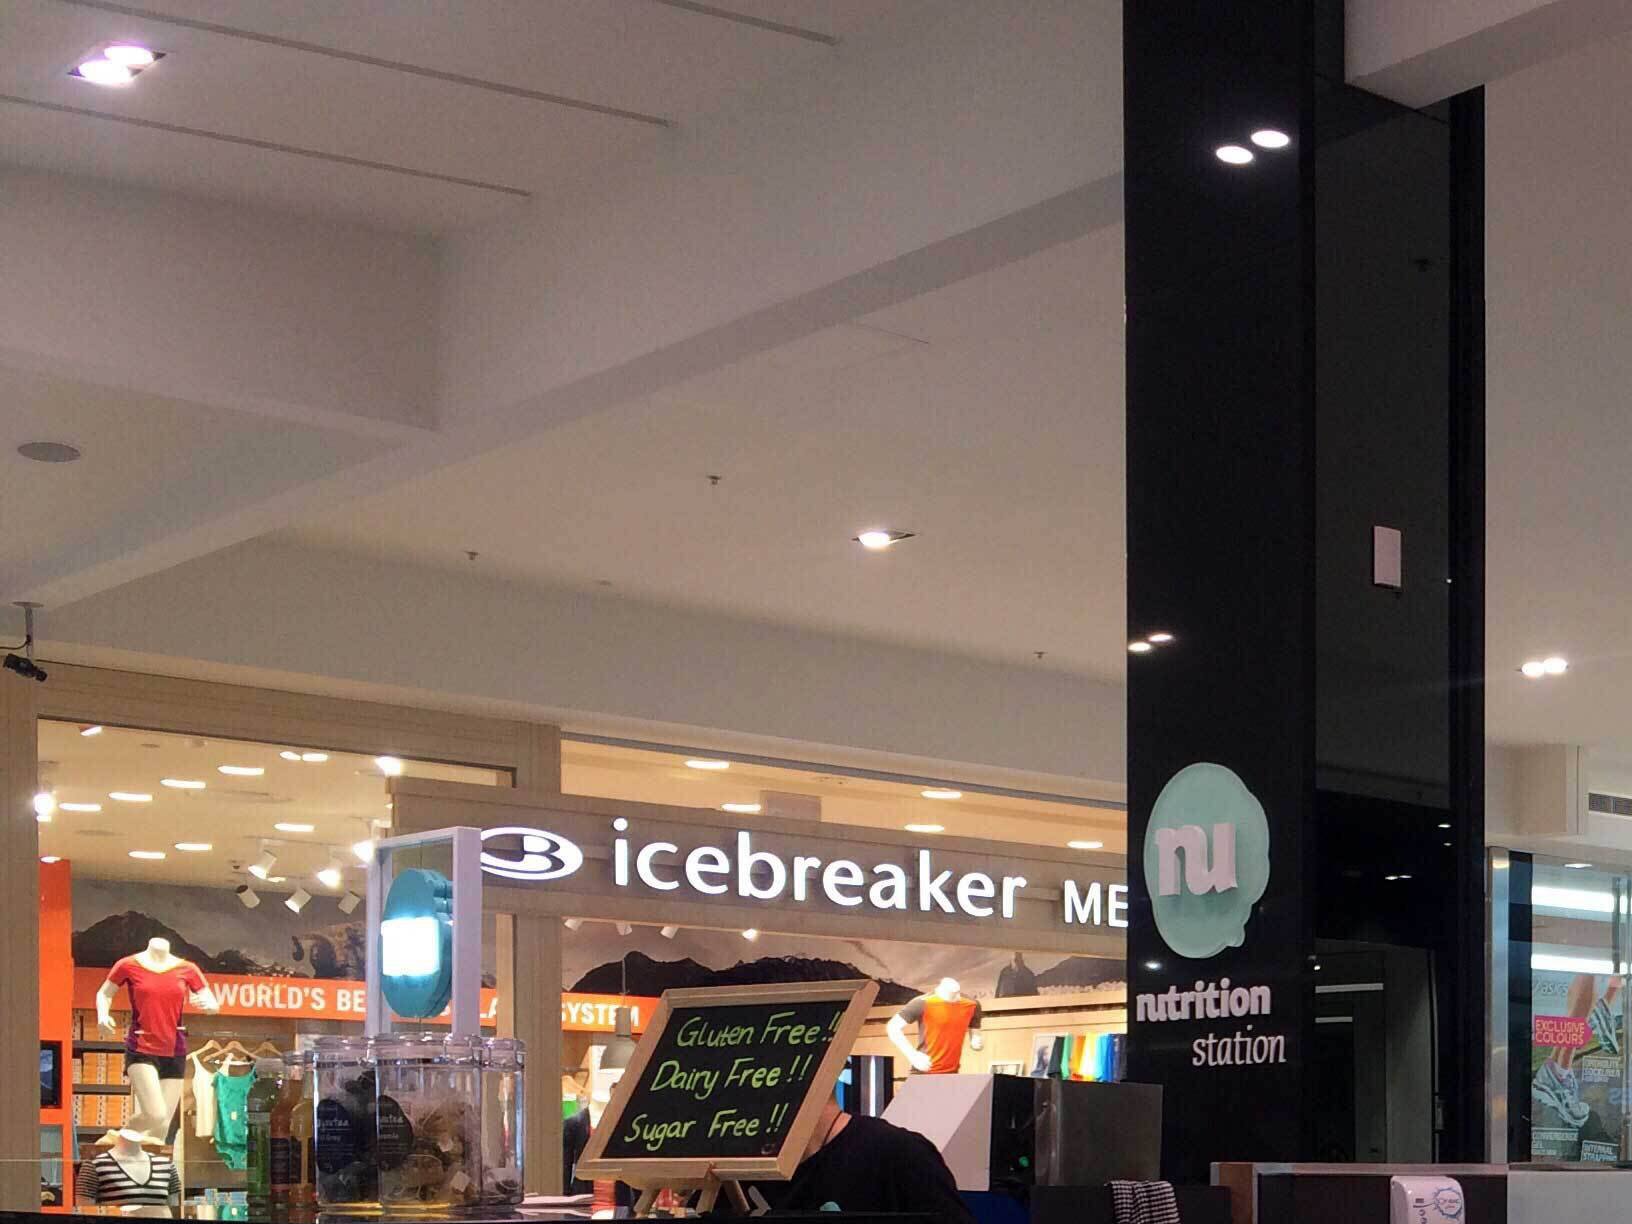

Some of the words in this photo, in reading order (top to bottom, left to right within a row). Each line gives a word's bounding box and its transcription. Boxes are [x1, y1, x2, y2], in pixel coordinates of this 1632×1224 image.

[612, 817, 1026, 920] icebreaker
[1153, 823, 1239, 897] nu
[217, 983, 326, 1011] WORLD'S
[562, 1003, 640, 1027] SYSTE
[1136, 978, 1272, 1022] nutrition
[676, 1016, 755, 1048] Gluten
[1192, 1025, 1288, 1067] station
[1535, 1019, 1585, 1034] EXCLUSIVE
[1535, 1031, 1585, 1045] COLOURS
[650, 1059, 719, 1100] Dairy
[624, 1113, 697, 1151] Sugar
